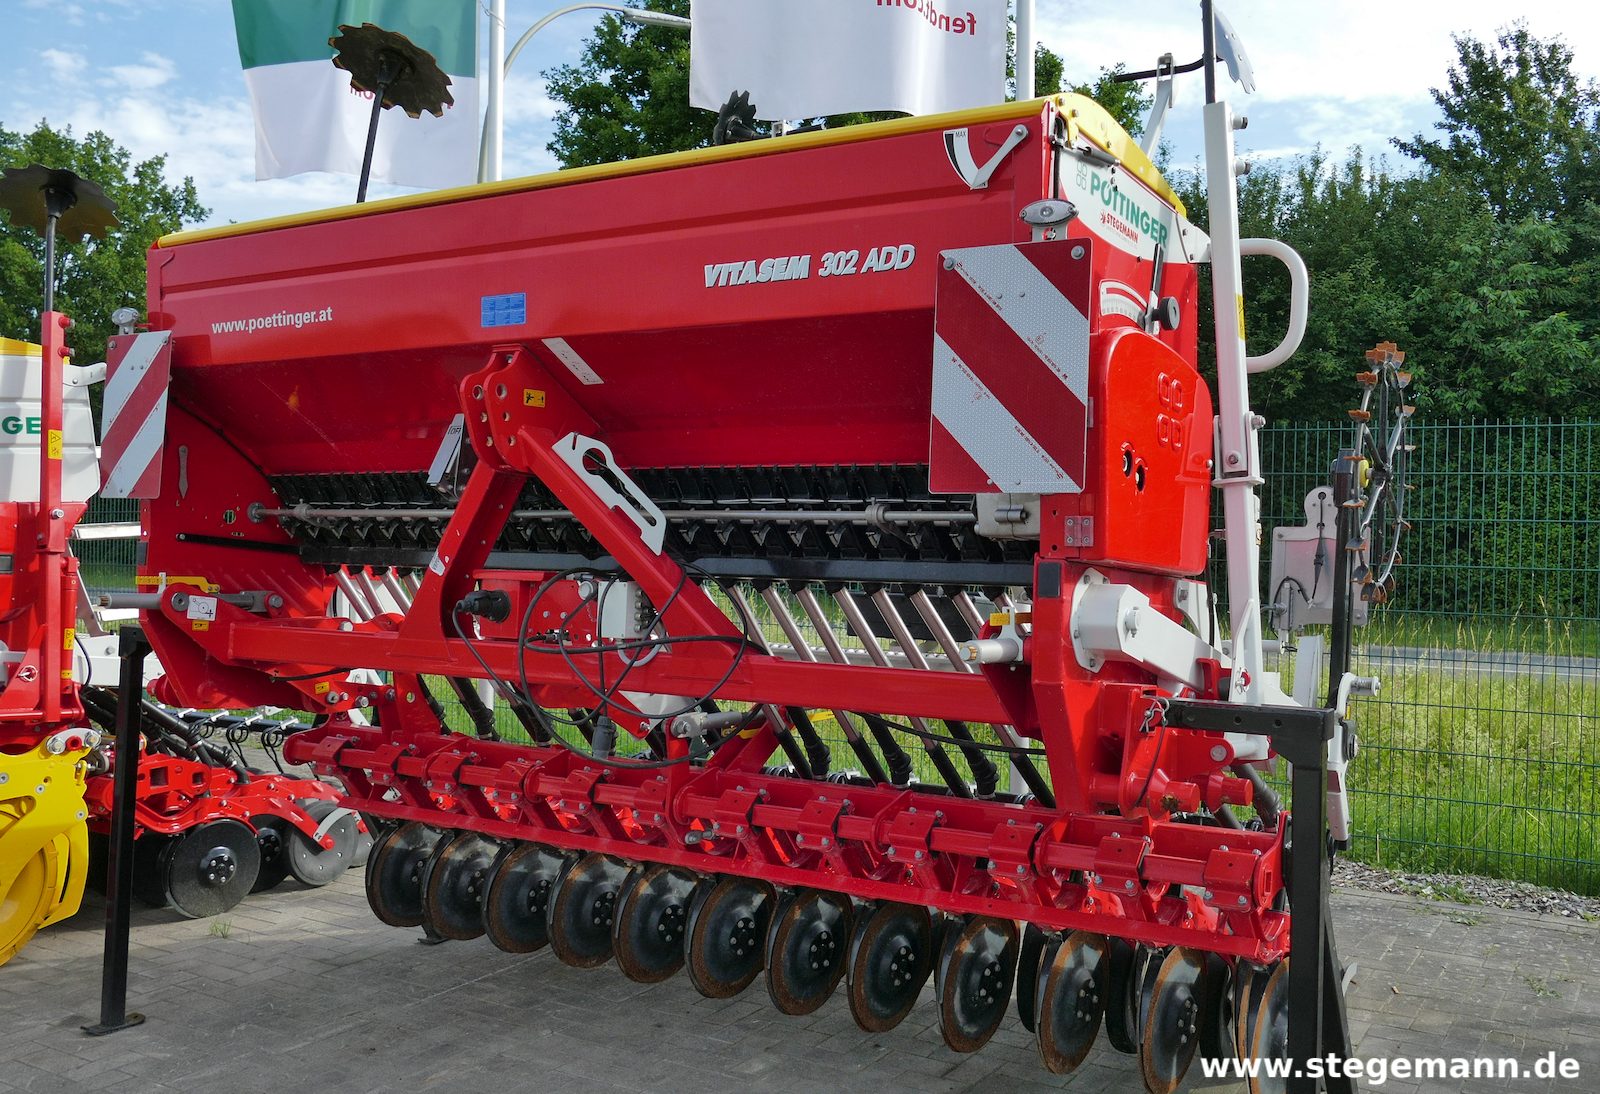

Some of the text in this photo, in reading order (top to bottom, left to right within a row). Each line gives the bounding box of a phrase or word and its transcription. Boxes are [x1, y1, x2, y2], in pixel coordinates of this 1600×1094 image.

[1106, 213, 1139, 243] STEGEMANN
[704, 244, 915, 288] VITASEM 302 ADD
[211, 306, 333, 334] www.poettinger.at
